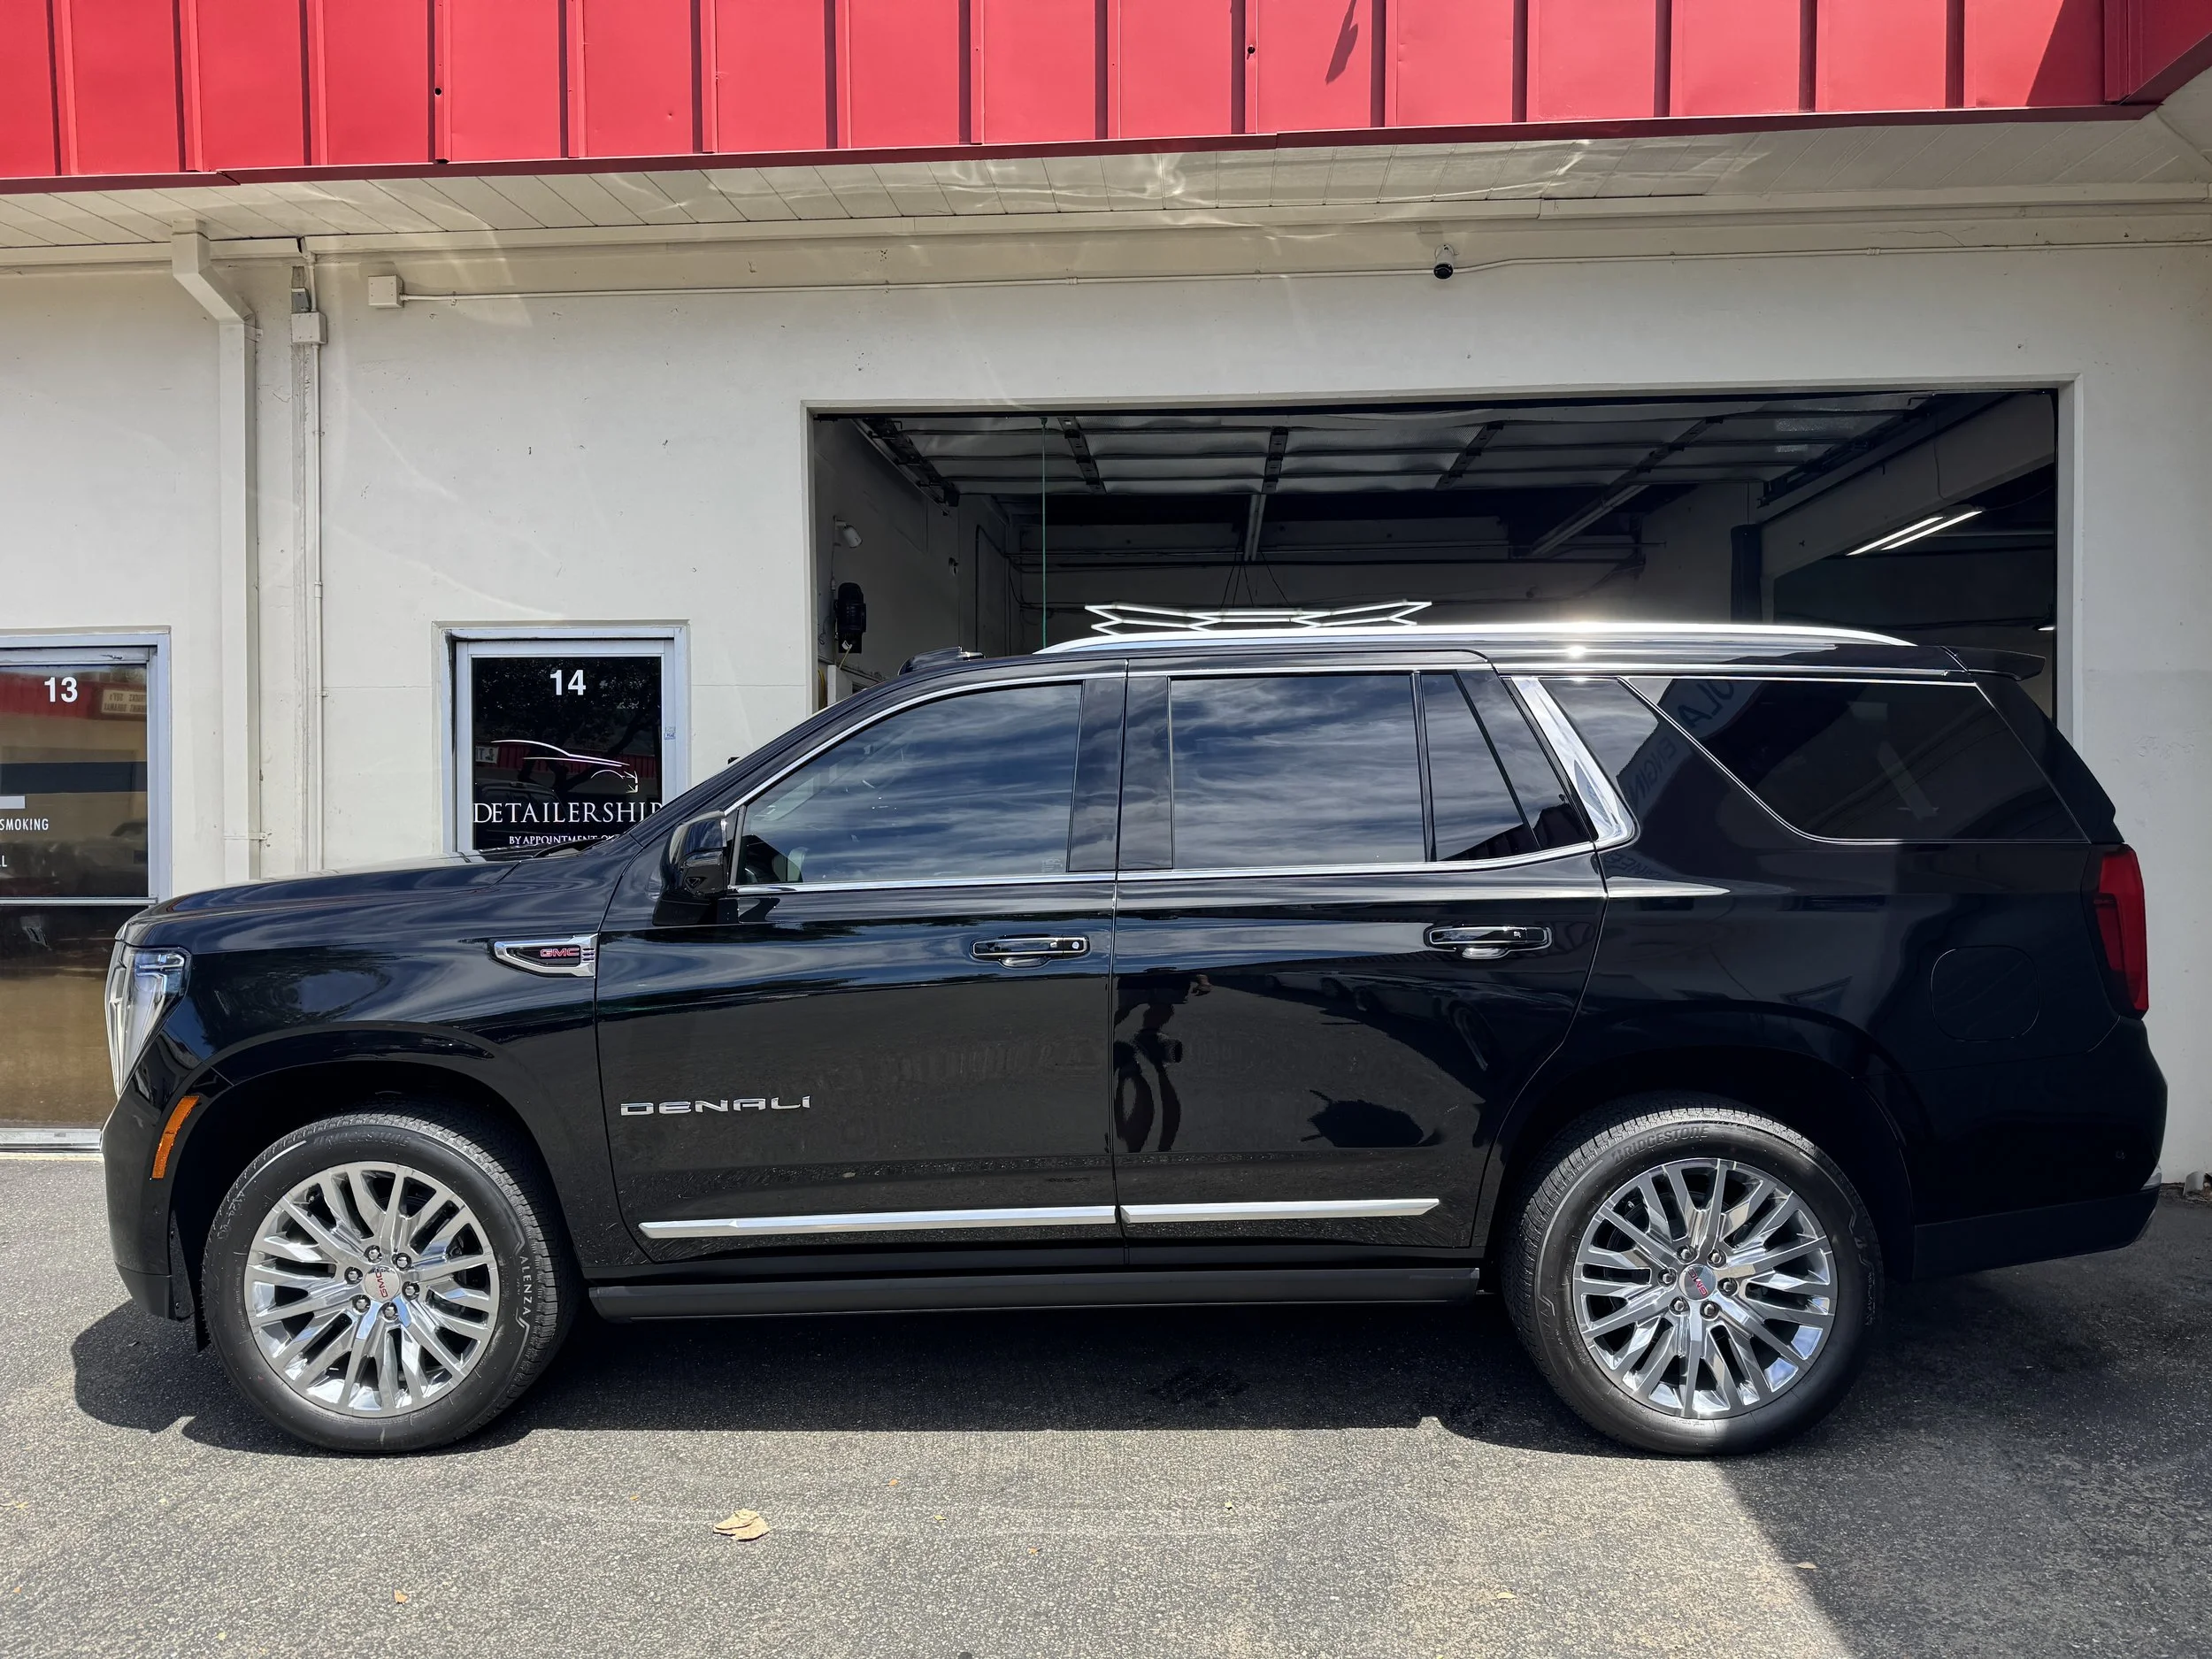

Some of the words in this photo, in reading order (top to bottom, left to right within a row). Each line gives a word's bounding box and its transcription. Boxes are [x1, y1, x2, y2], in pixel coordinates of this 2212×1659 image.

[44, 677, 78, 703] 13
[549, 670, 587, 695] 14
[0, 818, 49, 830] SMOKING
[509, 835, 521, 844] BY
[540, 947, 580, 957] GMC
[620, 1095, 810, 1116] DENALI
[374, 1267, 388, 1298] GMC
[519, 1256, 533, 1317] ALENZA
